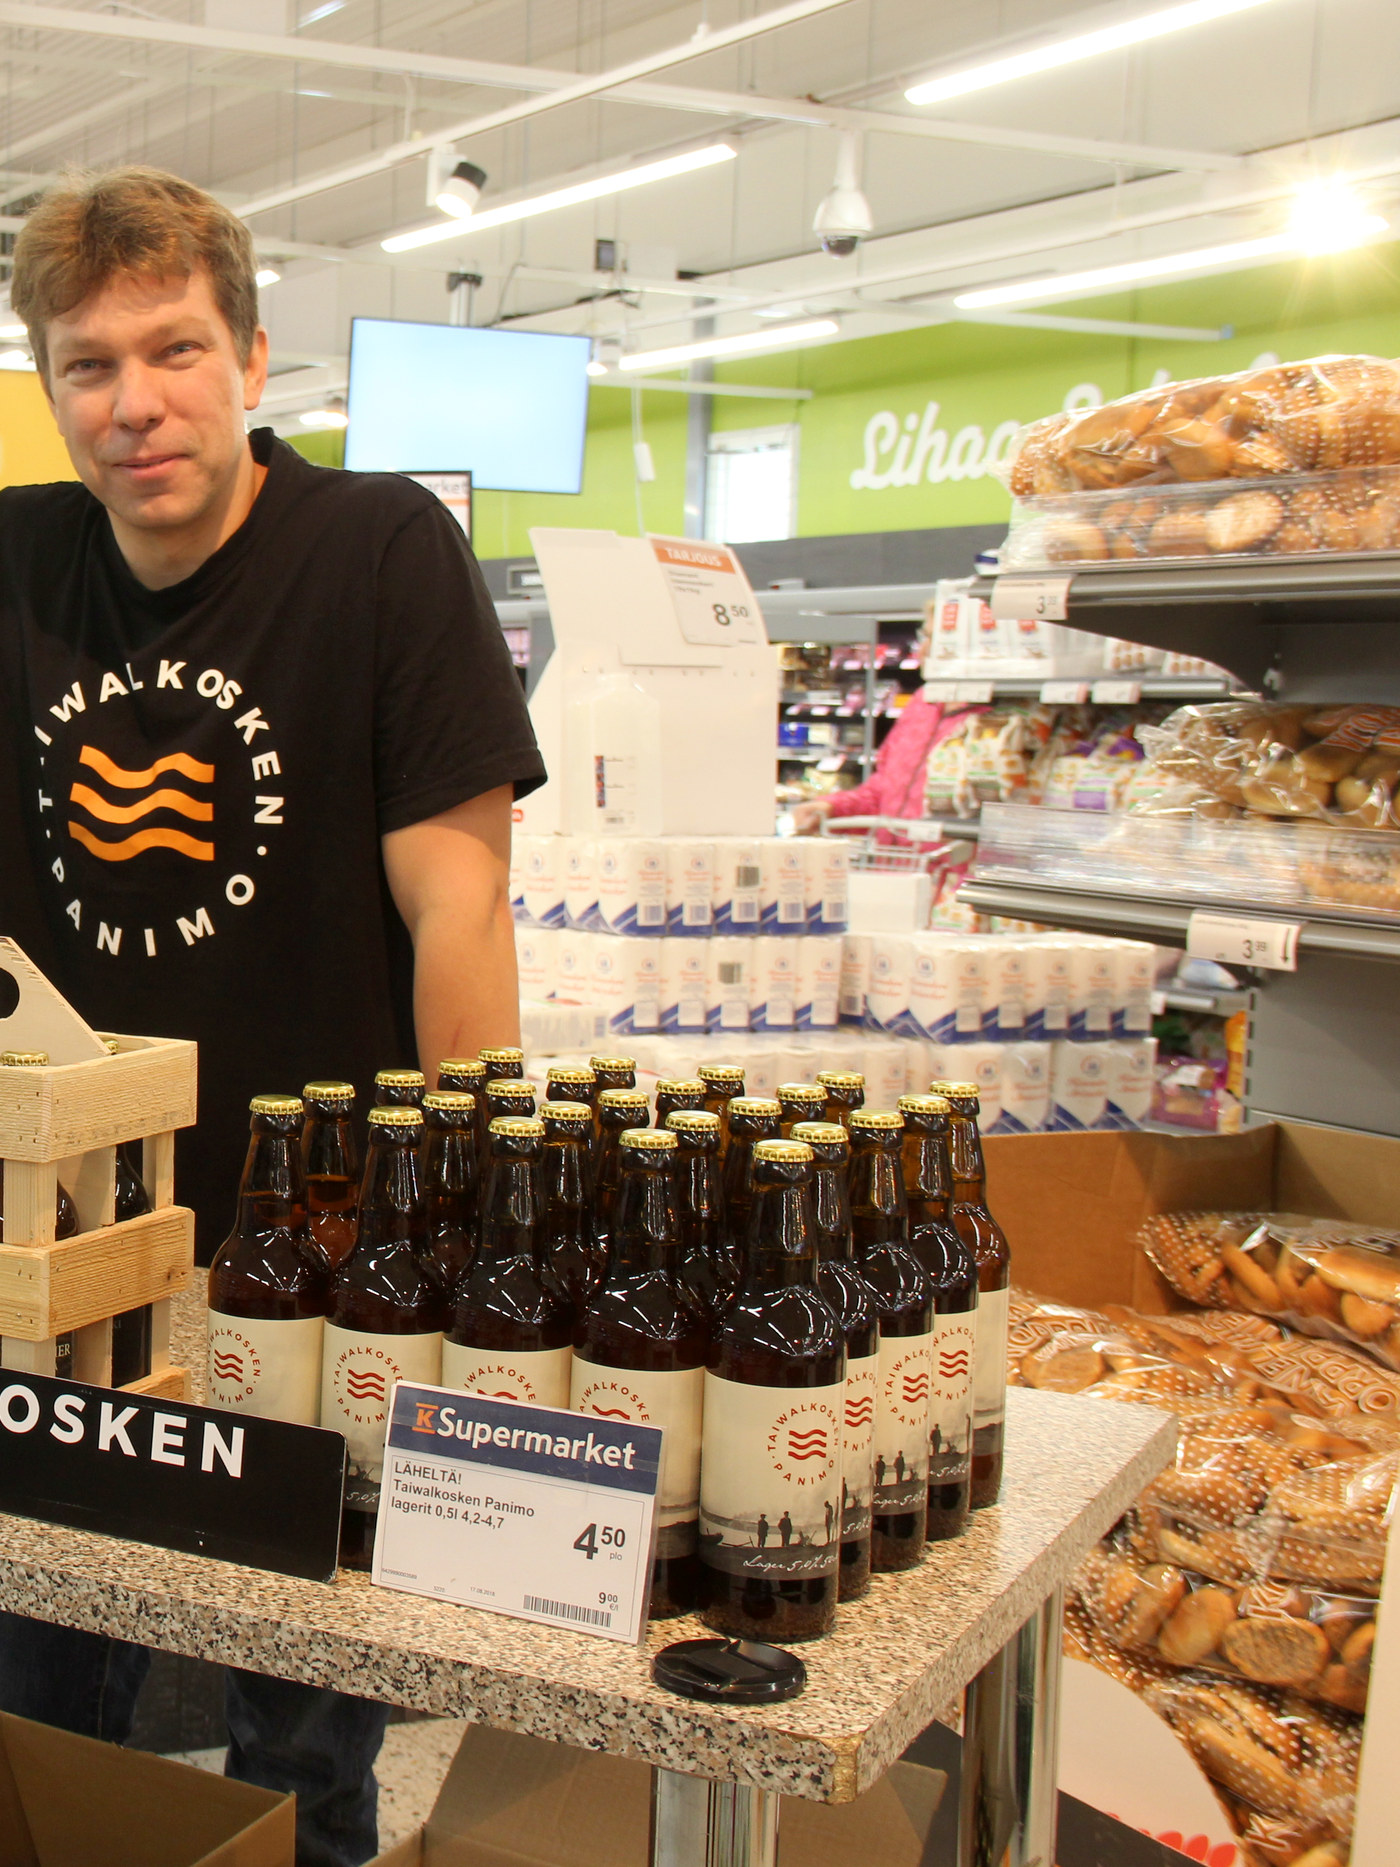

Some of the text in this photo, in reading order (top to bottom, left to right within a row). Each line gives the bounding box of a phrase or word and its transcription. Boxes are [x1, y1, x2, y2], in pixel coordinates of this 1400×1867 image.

[665, 547, 722, 567] TARJOUS
[712, 604, 731, 626] 8
[34, 659, 284, 813] TIWALKOSKEN
[52, 857, 254, 957] PANIMO
[1241, 939, 1253, 960] 3
[333, 1346, 403, 1386] TAIWALKOSKE
[337, 1397, 386, 1424] PANIM
[437, 1406, 637, 1471] Supermarket
[394, 1460, 462, 1485] LÄHELTÄ!
[774, 1459, 835, 1486] PANIMO
[391, 1497, 433, 1517] lagerit
[461, 1509, 505, 1530] 4,2-4,7
[393, 1479, 535, 1518] Taiwalkosken Panimo
[573, 1522, 599, 1561] 4
[609, 1550, 623, 1562] plo
